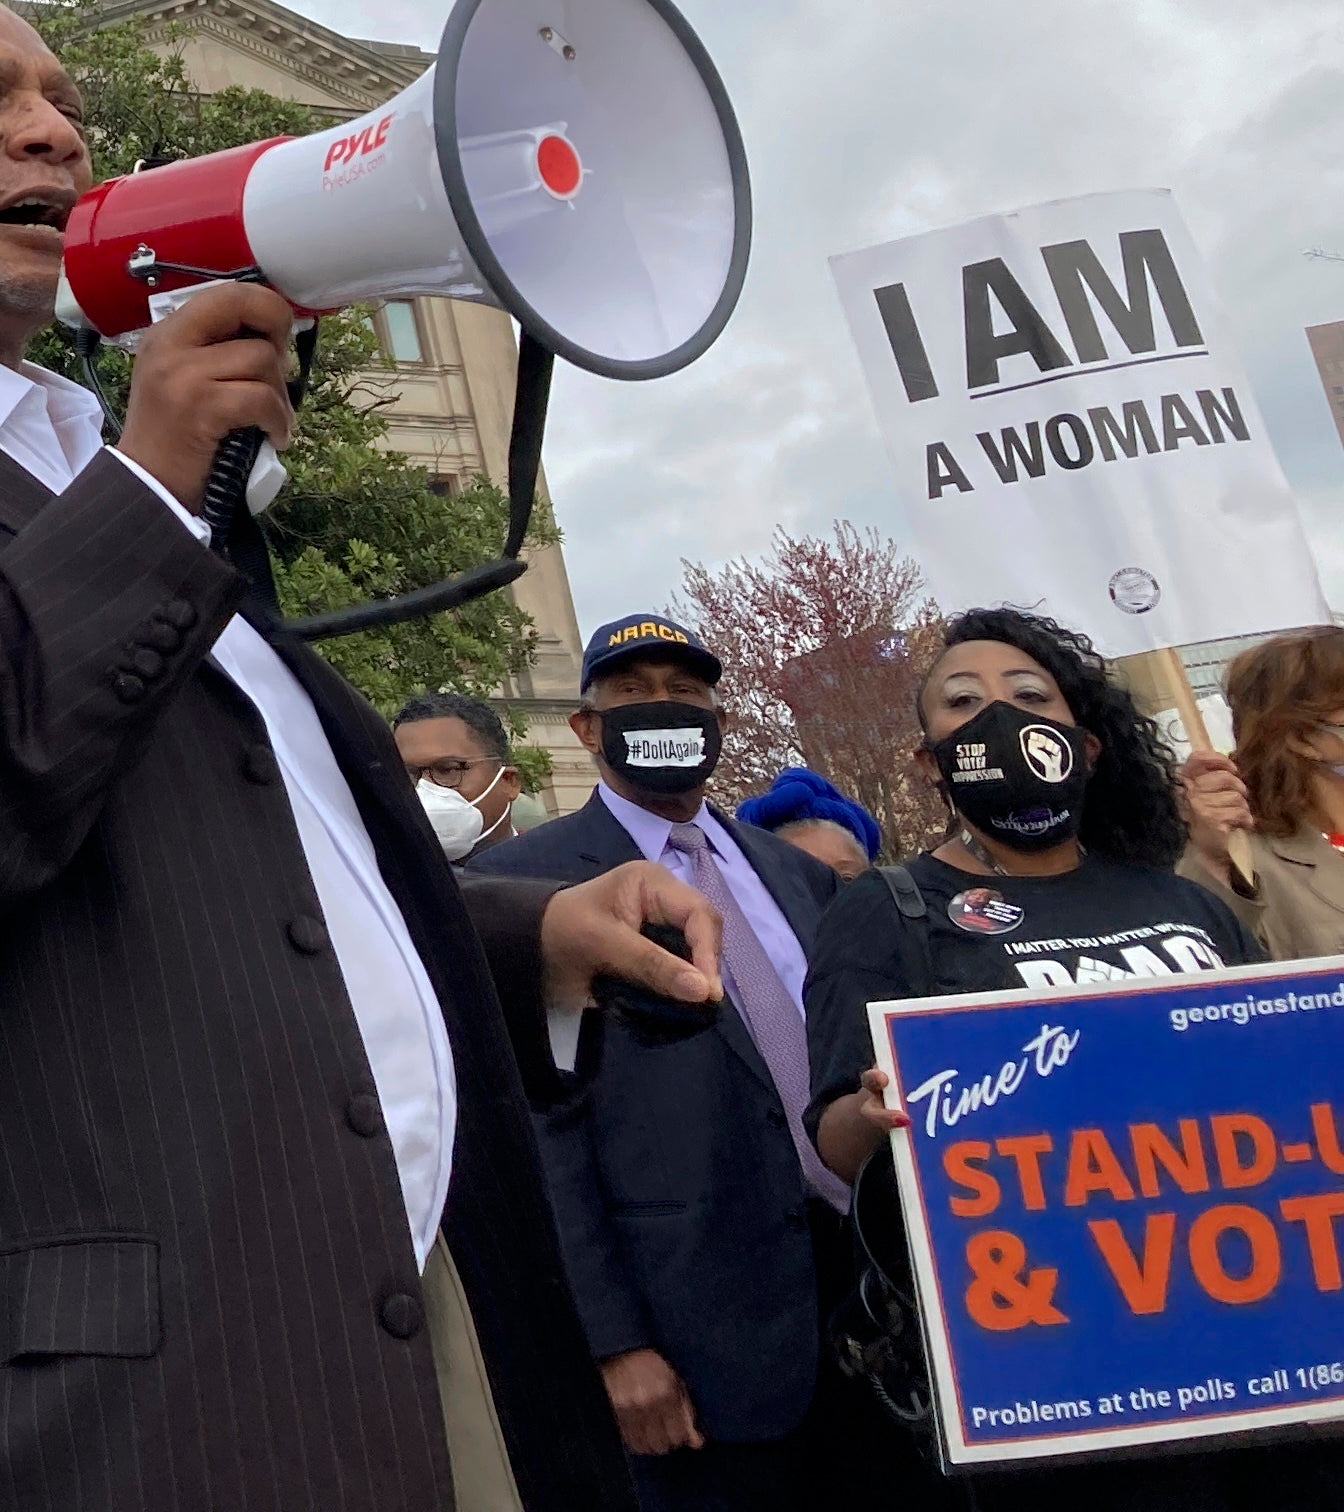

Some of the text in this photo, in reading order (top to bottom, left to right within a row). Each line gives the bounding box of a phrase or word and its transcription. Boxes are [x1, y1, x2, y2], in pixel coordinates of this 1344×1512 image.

[324, 112, 395, 172] PYLE
[873, 282, 939, 403] I
[962, 229, 1205, 389] AM
[926, 442, 974, 499] A
[977, 387, 1251, 484] WOMAN
[630, 737, 700, 762] #DoItAgain
[956, 743, 986, 758] STOP
[1004, 942, 1013, 955] I
[1067, 936, 1100, 948] YOU
[1169, 982, 1344, 1031] georgiastand
[906, 1024, 1080, 1138] Time to
[964, 1192, 1344, 1332] & VOT
[972, 1399, 1092, 1429] Problems
[1098, 1395, 1124, 1416] at
[1130, 1387, 1171, 1411] the
[1177, 1378, 1236, 1412] polls
[1247, 1369, 1290, 1397] call
